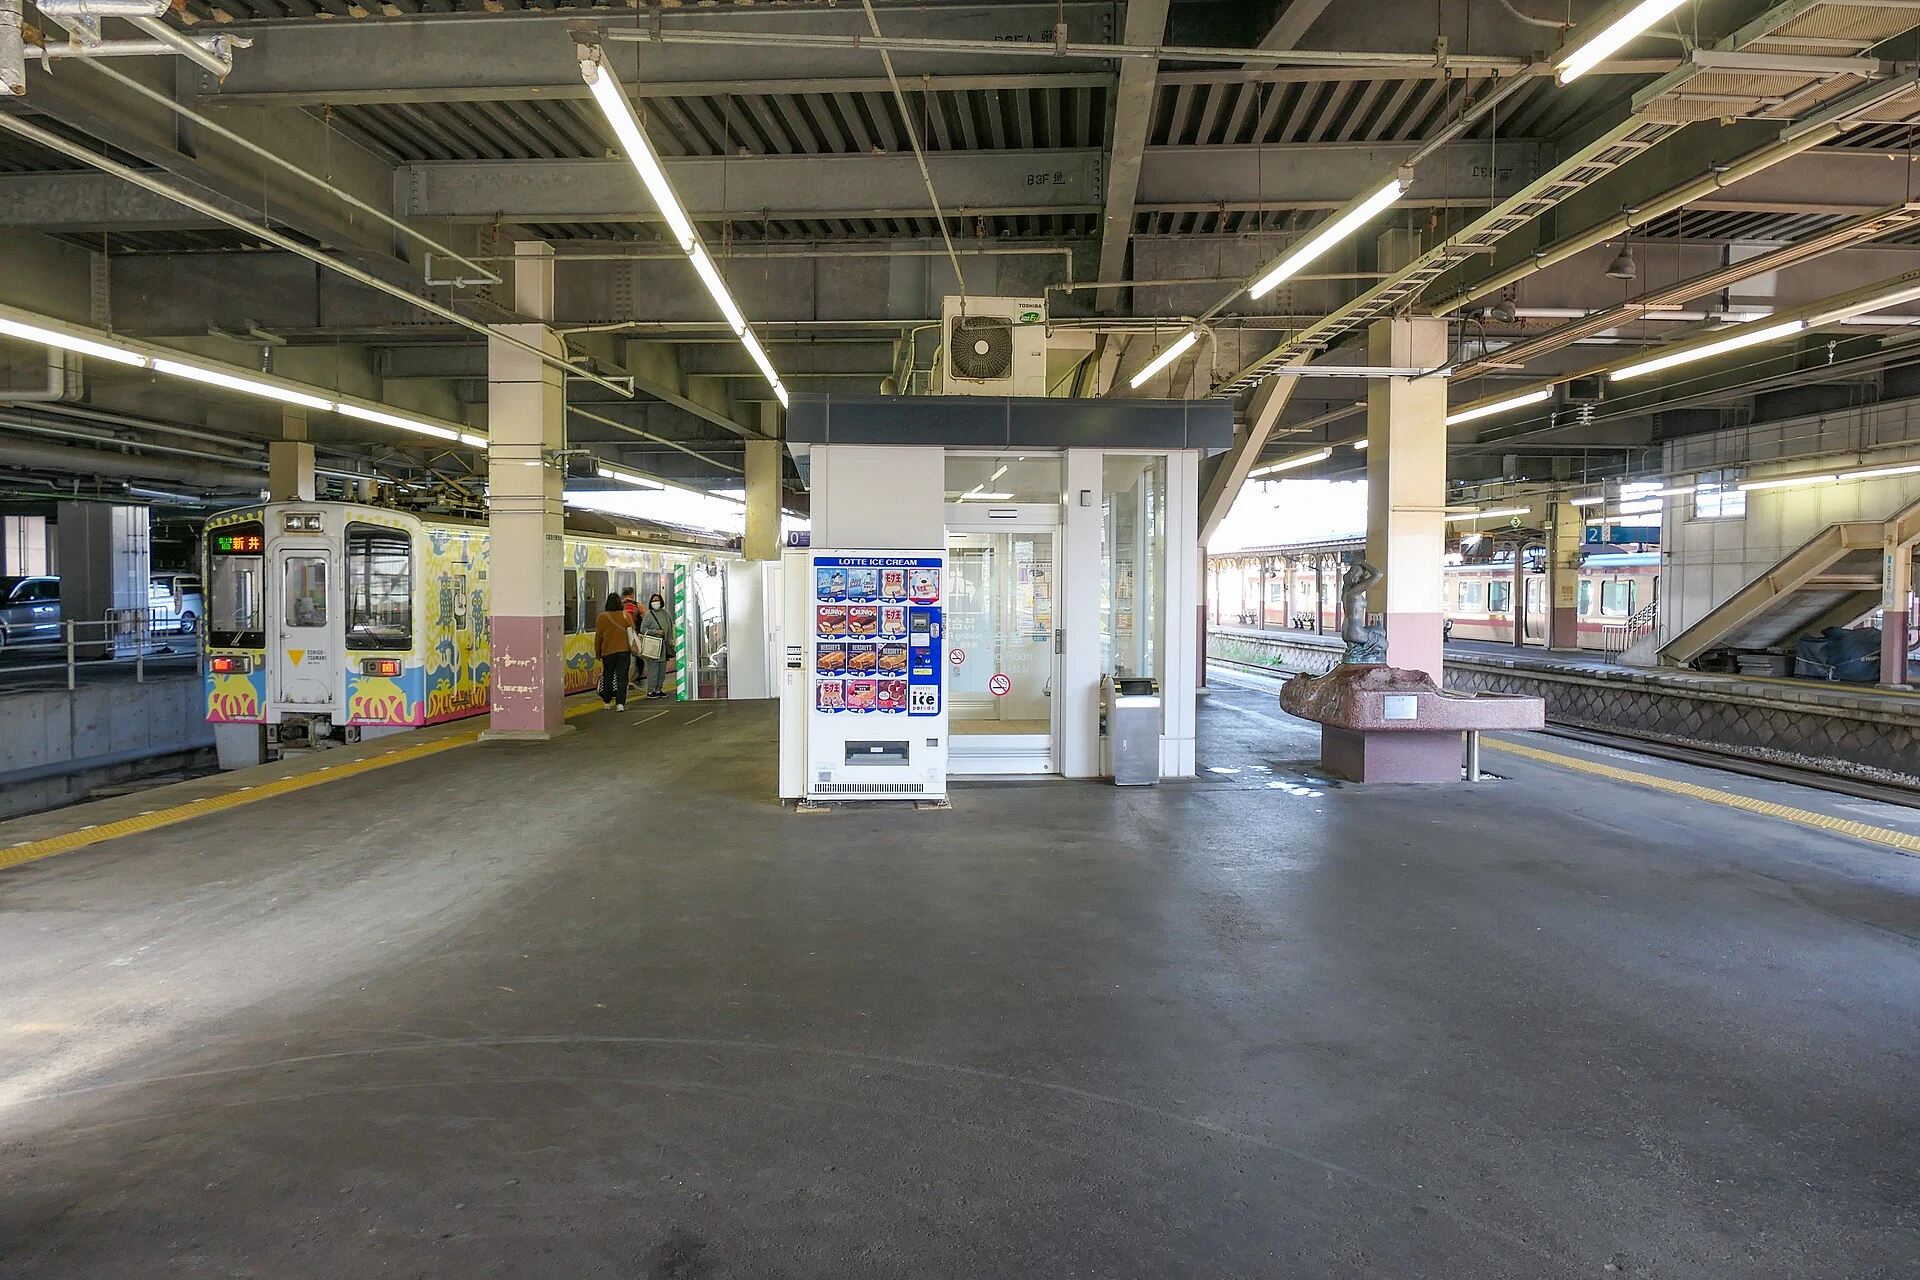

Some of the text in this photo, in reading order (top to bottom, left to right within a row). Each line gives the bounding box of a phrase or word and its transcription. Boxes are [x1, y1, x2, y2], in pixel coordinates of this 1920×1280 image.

[1028, 174, 1049, 185] B3F
[1513, 518, 1519, 526] 3
[790, 532, 799, 545] 0
[1589, 528, 1598, 542] 2
[232, 537, 260, 550] 新井
[885, 573, 901, 583] モナ王
[885, 610, 901, 620] モナ王
[823, 683, 840, 693] モナ王
[912, 691, 935, 705] ice
